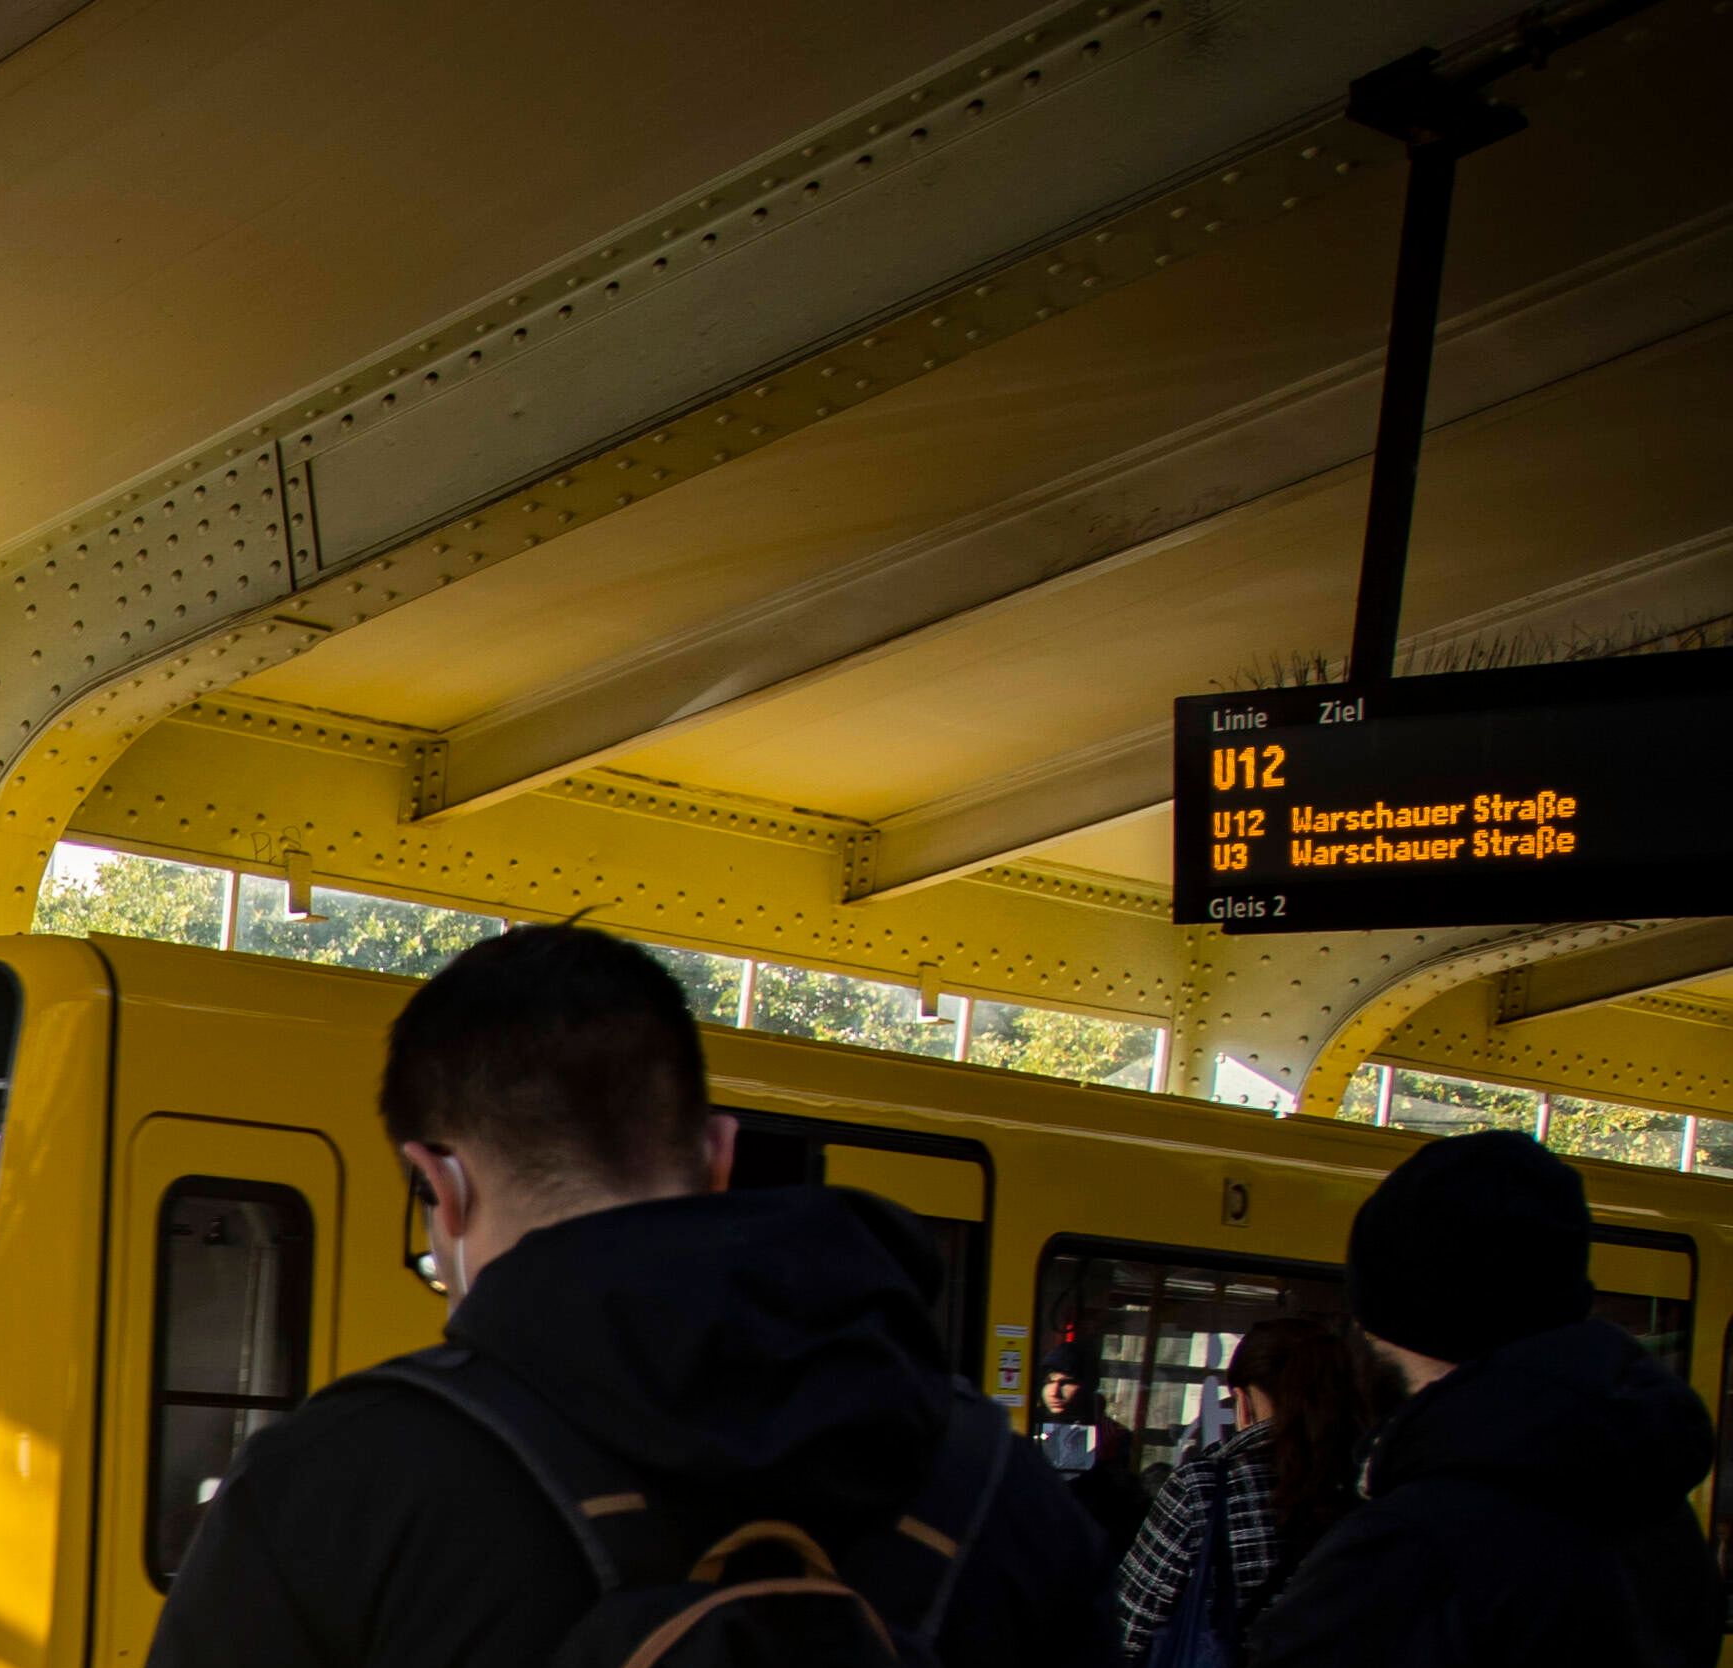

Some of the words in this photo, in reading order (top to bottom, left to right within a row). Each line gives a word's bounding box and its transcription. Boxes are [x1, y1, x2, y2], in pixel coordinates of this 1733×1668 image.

[1213, 708, 1268, 732] Linie
[1319, 698, 1364, 725] Ziel
[1212, 744, 1286, 791] U12
[1213, 809, 1266, 839] U12
[1291, 801, 1466, 834] Warschauer
[1473, 790, 1577, 828] Straße
[1213, 842, 1248, 871] U3
[1291, 835, 1466, 867] Warschauer
[1472, 825, 1576, 860] Straße
[1208, 896, 1267, 920] Gleis
[1273, 895, 1287, 917] 2
